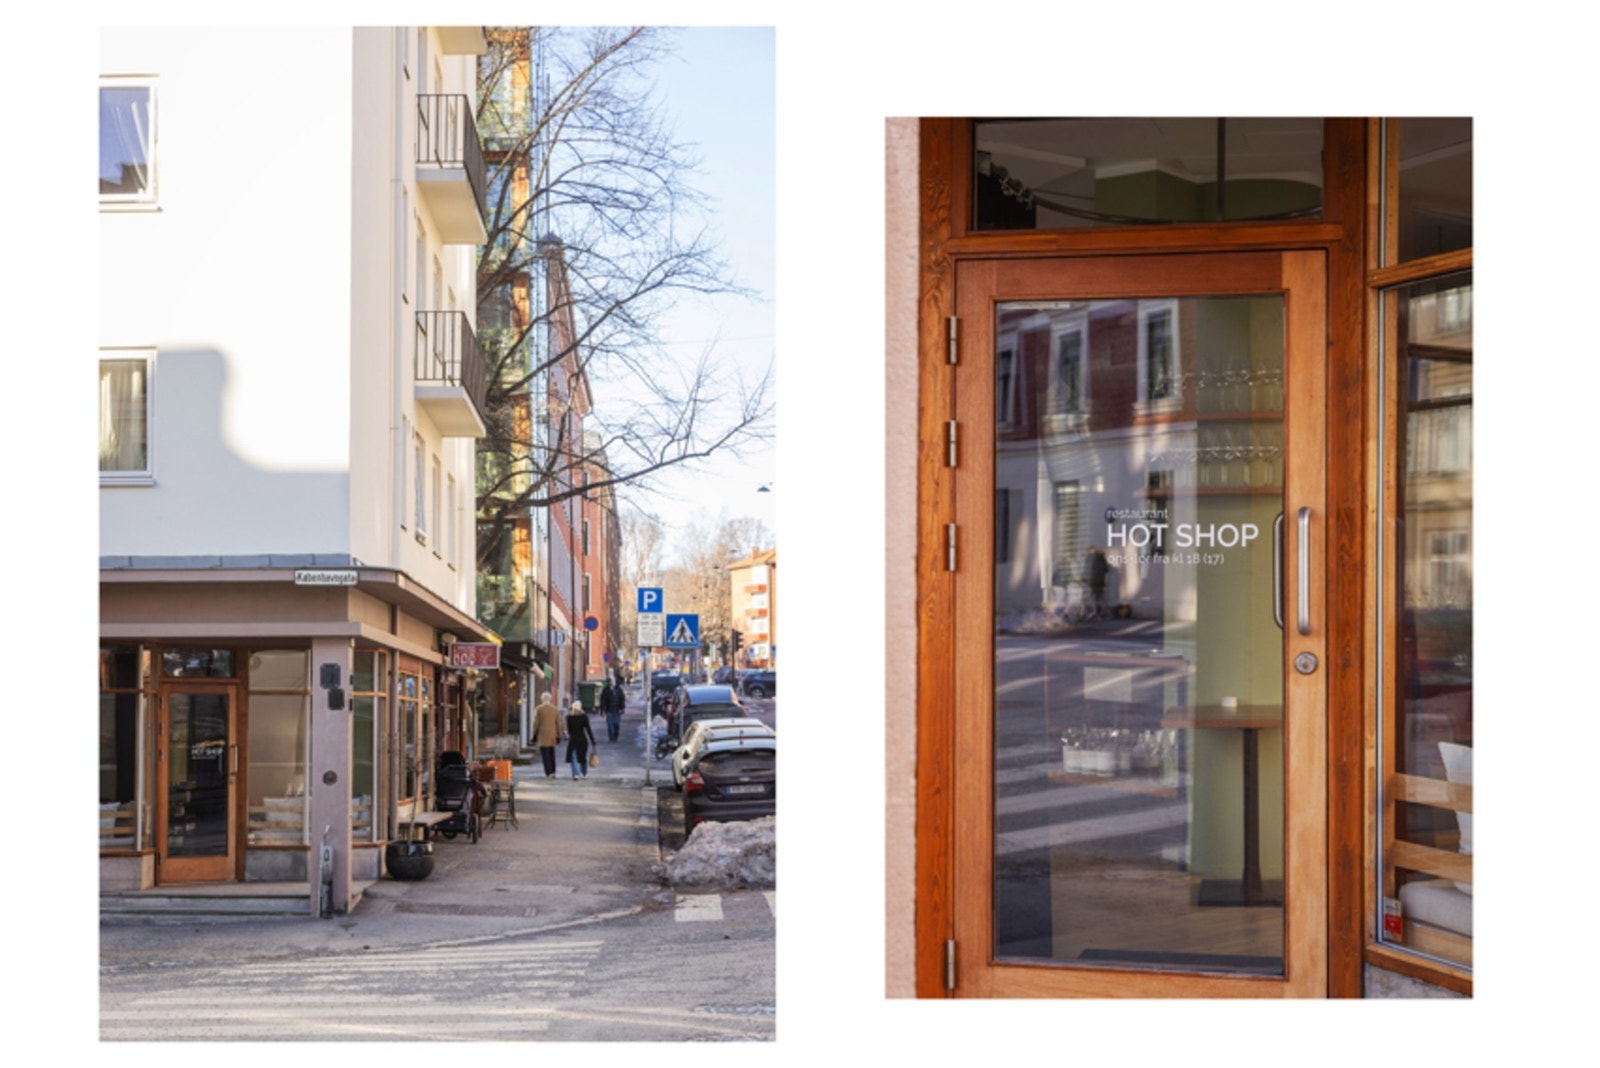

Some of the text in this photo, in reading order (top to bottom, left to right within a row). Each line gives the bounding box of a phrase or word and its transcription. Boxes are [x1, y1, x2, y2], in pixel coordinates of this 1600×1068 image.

[1107, 507, 1169, 519] restaurant
[1107, 523, 1259, 548] HOT SHOP
[1153, 552, 1170, 564] fra
[1172, 552, 1184, 564] kl
[1187, 554, 1200, 565] 18
[1203, 552, 1224, 566] (17)
[643, 591, 657, 610] P
